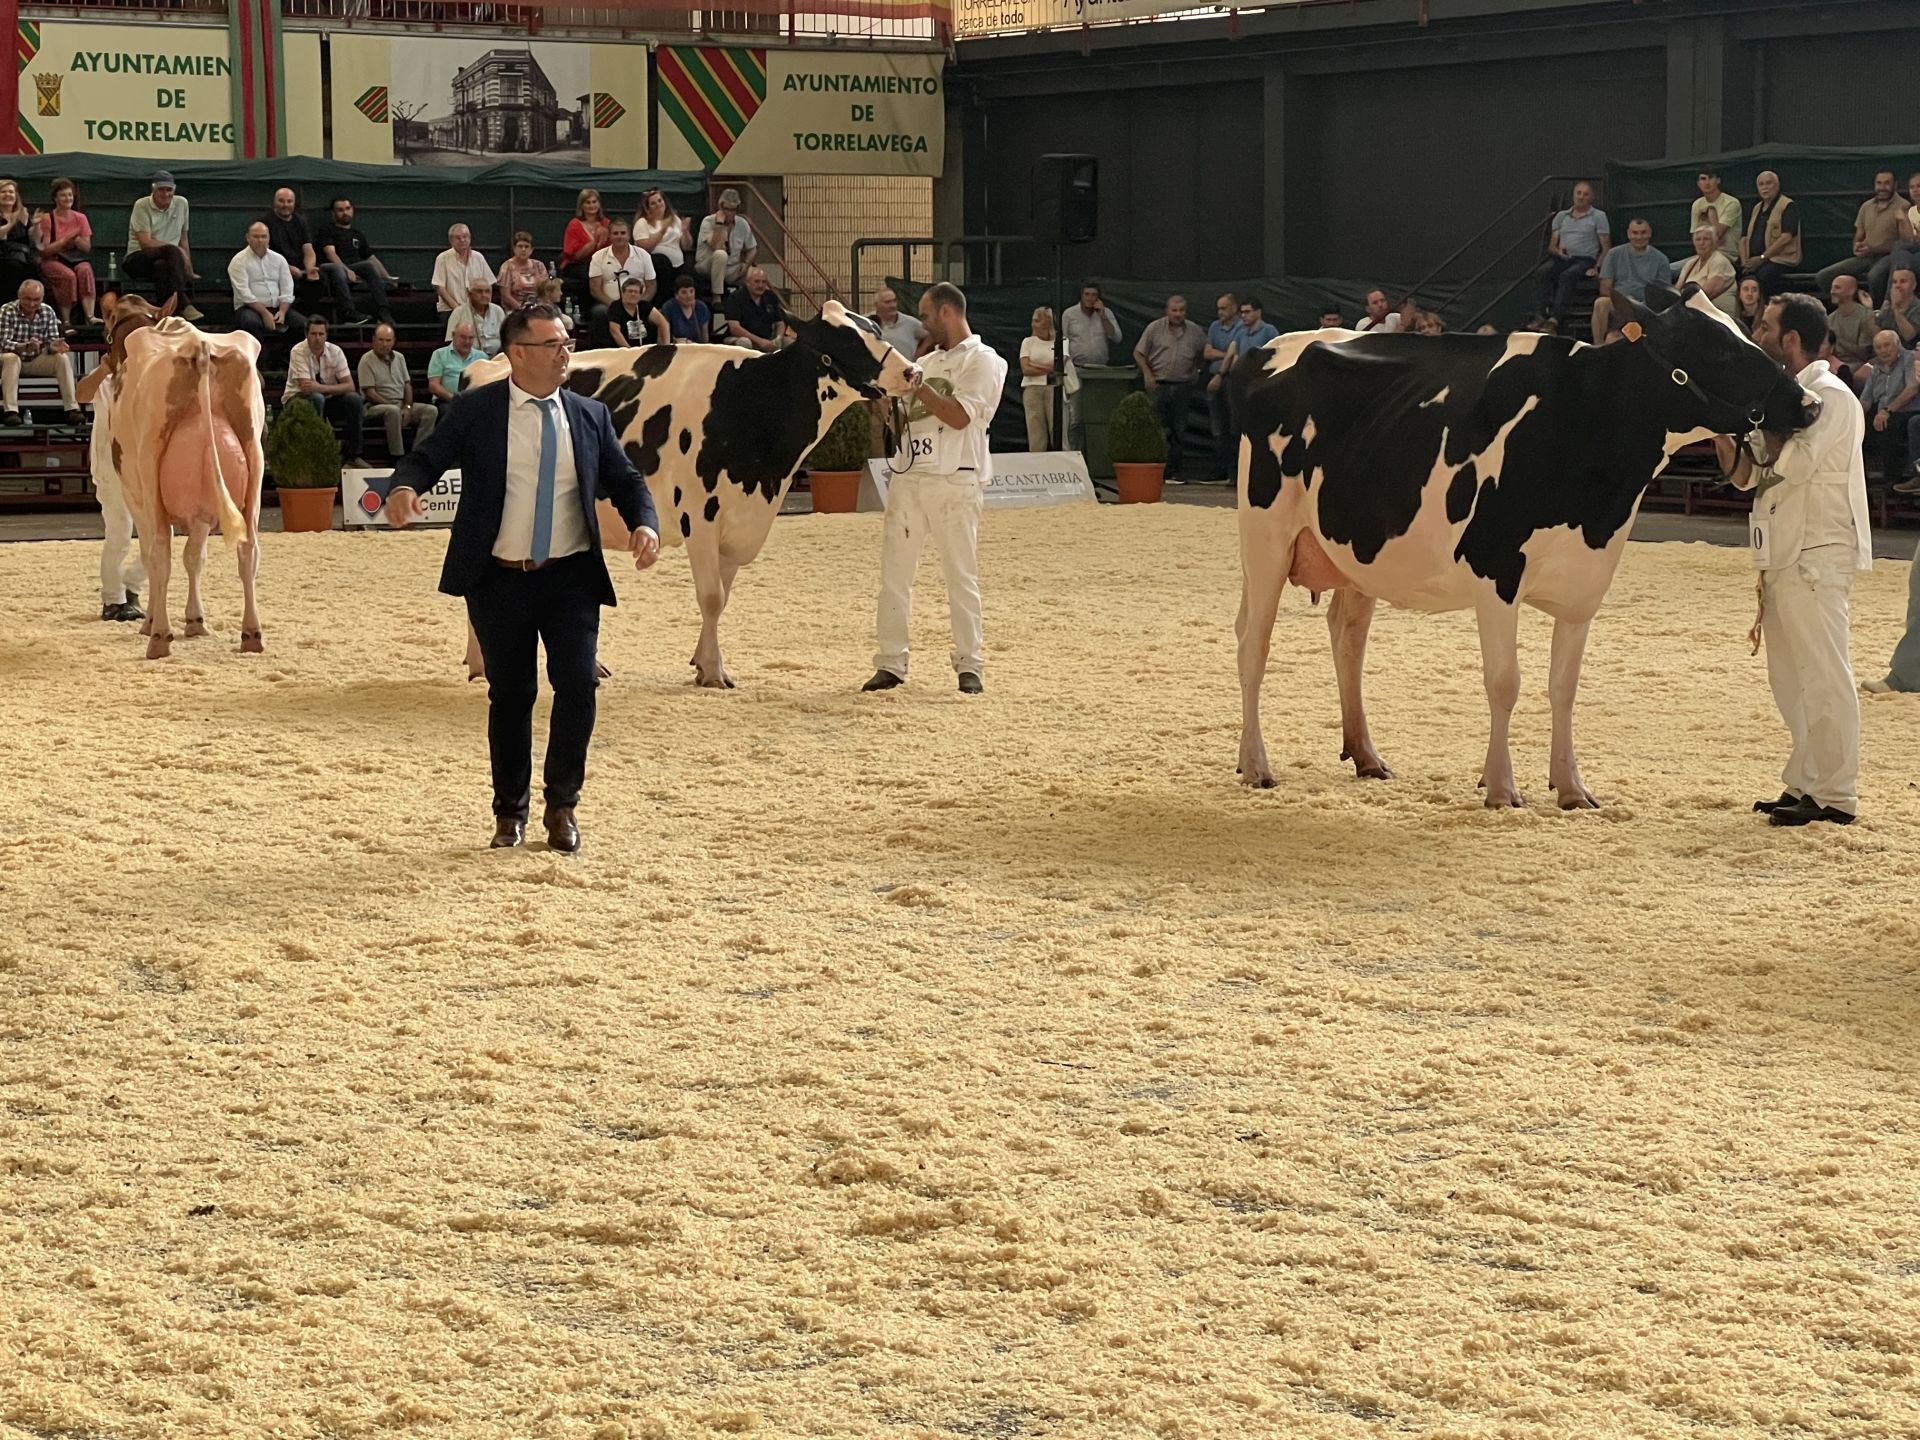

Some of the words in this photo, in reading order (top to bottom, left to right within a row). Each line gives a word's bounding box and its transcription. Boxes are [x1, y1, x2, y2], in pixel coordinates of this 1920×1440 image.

[958, 17, 984, 30] cerca
[986, 12, 998, 27] de
[1000, 10, 1024, 26] todo
[783, 73, 938, 96] AYUNTAMIENTO
[156, 88, 187, 109] DE
[851, 104, 875, 122] DE
[793, 132, 929, 153] TORRELAVEGA
[911, 437, 933, 456] 28
